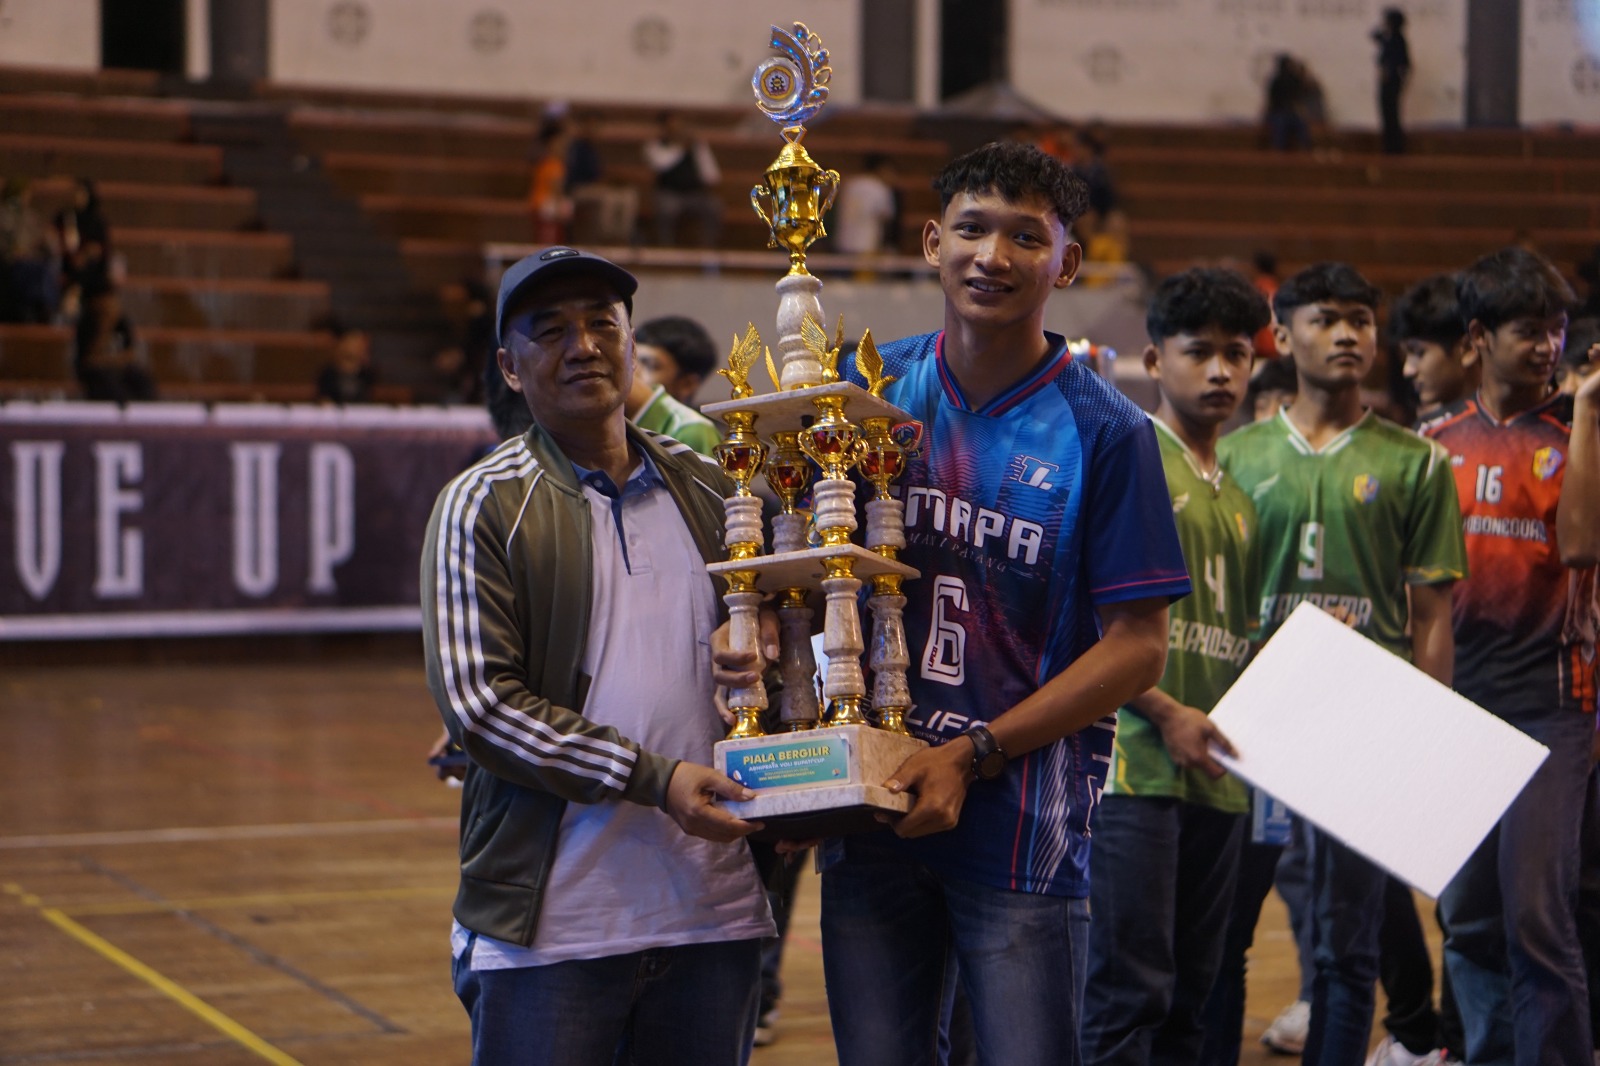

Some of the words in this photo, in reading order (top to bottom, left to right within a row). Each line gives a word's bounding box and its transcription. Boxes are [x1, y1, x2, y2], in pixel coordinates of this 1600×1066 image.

[1475, 463, 1503, 505] 16
[229, 440, 357, 596] UP
[889, 485, 1044, 566] MAPA
[1298, 521, 1324, 580] 9
[1204, 553, 1226, 613] 4
[920, 574, 970, 687] 6
[744, 753, 776, 765] PIALA
[779, 746, 830, 760] BERGILIR
